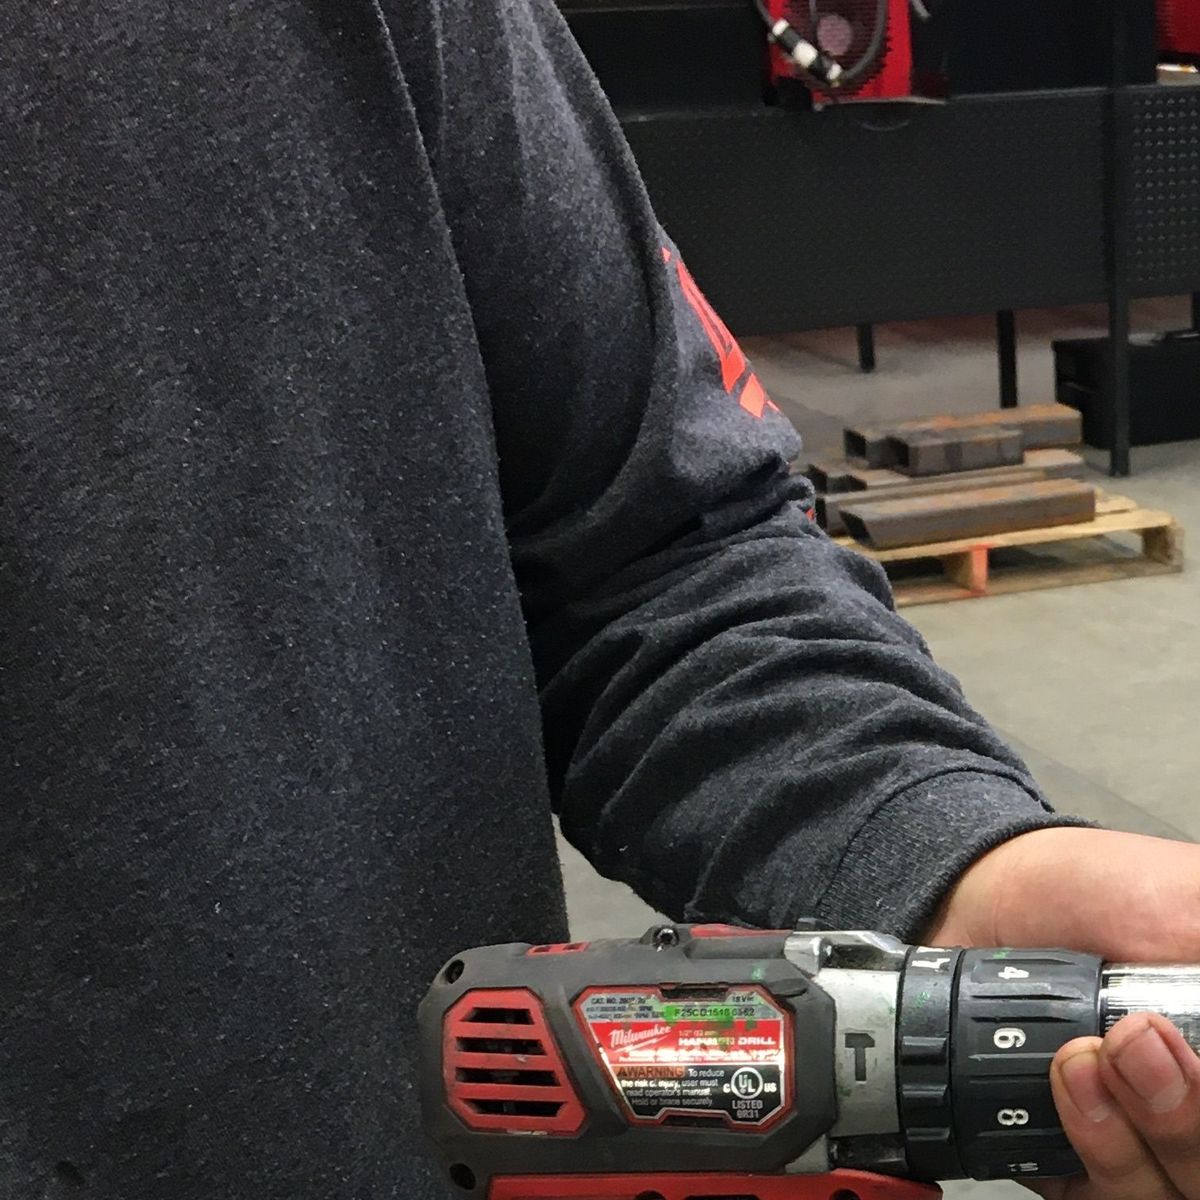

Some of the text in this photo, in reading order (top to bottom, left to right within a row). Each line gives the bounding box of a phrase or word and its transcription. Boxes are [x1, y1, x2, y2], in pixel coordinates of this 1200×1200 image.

[998, 966, 1030, 980] 4
[608, 1023, 671, 1049] Milwaukee
[737, 1036, 776, 1046] DRILL
[993, 1027, 1027, 1049] 6
[626, 1067, 725, 1078] WARNING To reduce
[732, 1099, 764, 1110] LISTED
[997, 1108, 1029, 1126] 8
